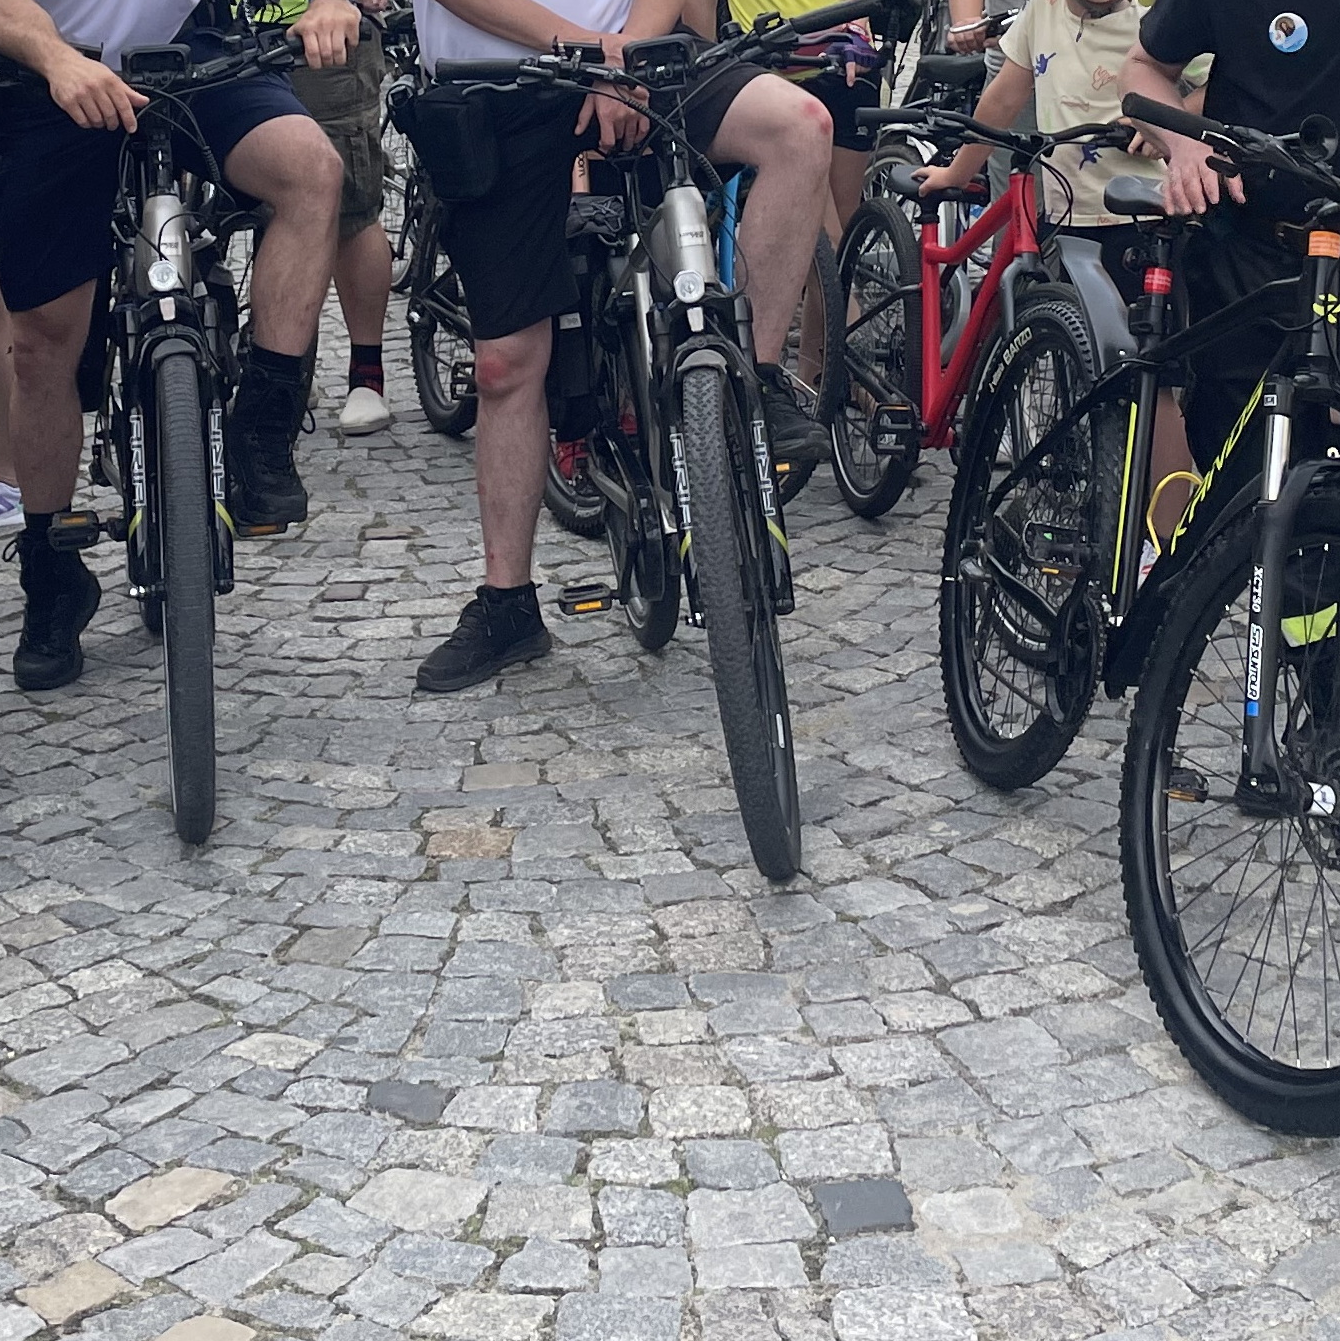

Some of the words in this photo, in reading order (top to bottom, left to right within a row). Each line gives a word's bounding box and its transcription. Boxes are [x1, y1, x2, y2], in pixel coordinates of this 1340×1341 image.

[129, 414, 147, 507] ARIA
[208, 408, 226, 501] ARIA
[669, 432, 693, 531] ARIA
[752, 419, 777, 517] ARIA
[1251, 566, 1264, 614] XCT30
[1246, 647, 1262, 699] SUNTOUR
